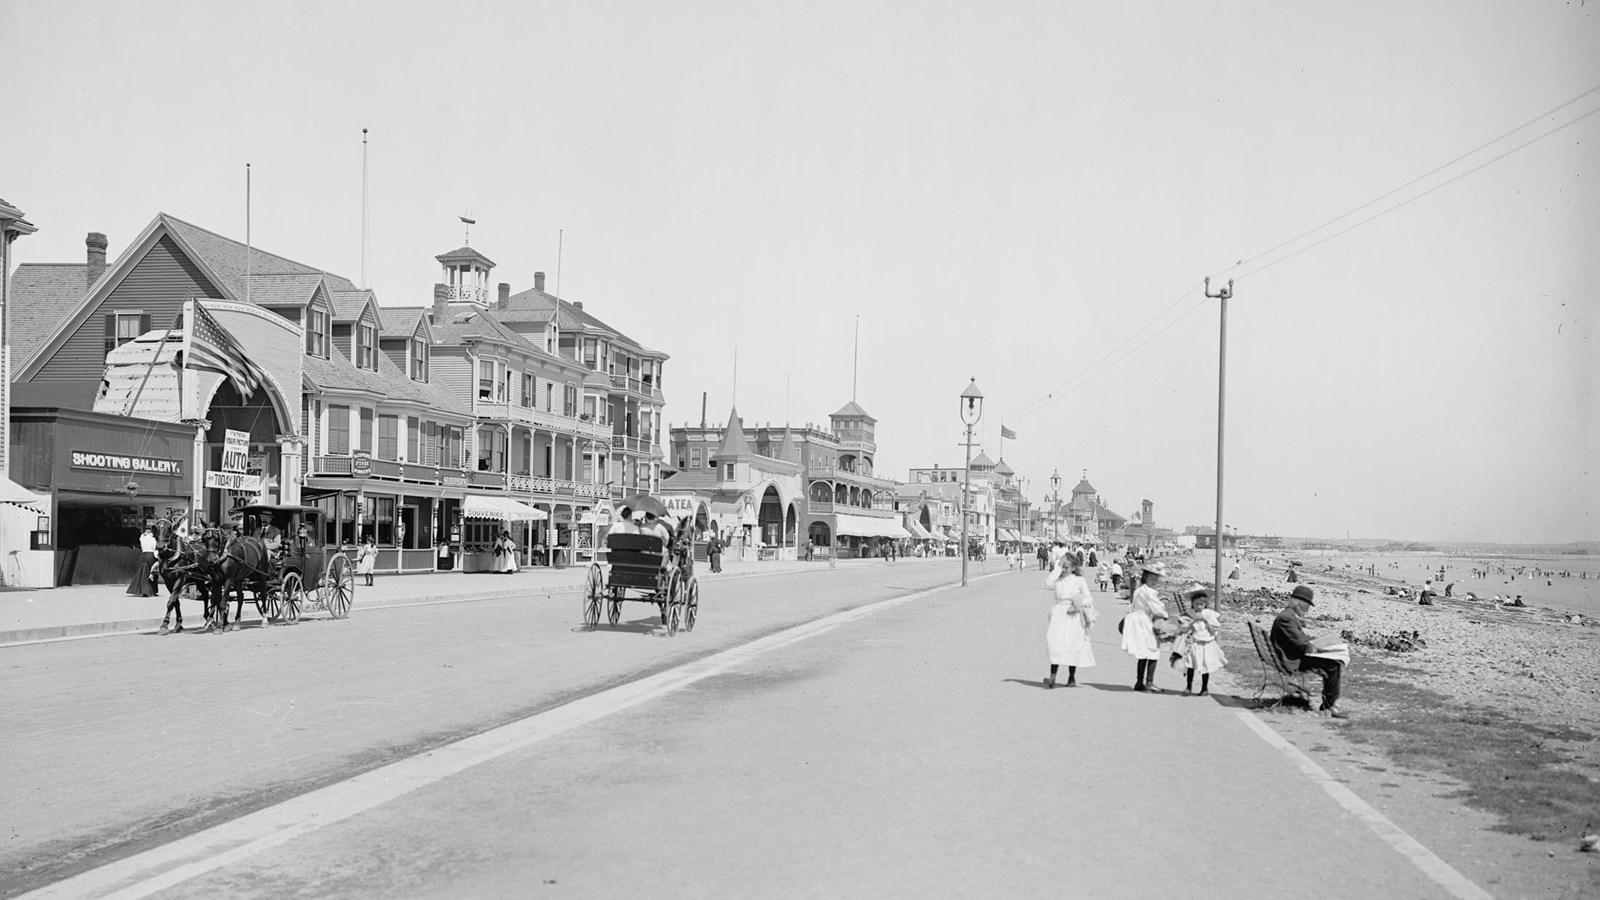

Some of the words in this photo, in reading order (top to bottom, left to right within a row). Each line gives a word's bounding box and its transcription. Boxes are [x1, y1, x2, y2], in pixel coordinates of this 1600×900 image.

[72, 452, 131, 469] SHOOTING
[223, 450, 247, 470] AUTO
[214, 473, 233, 487] TODAY
